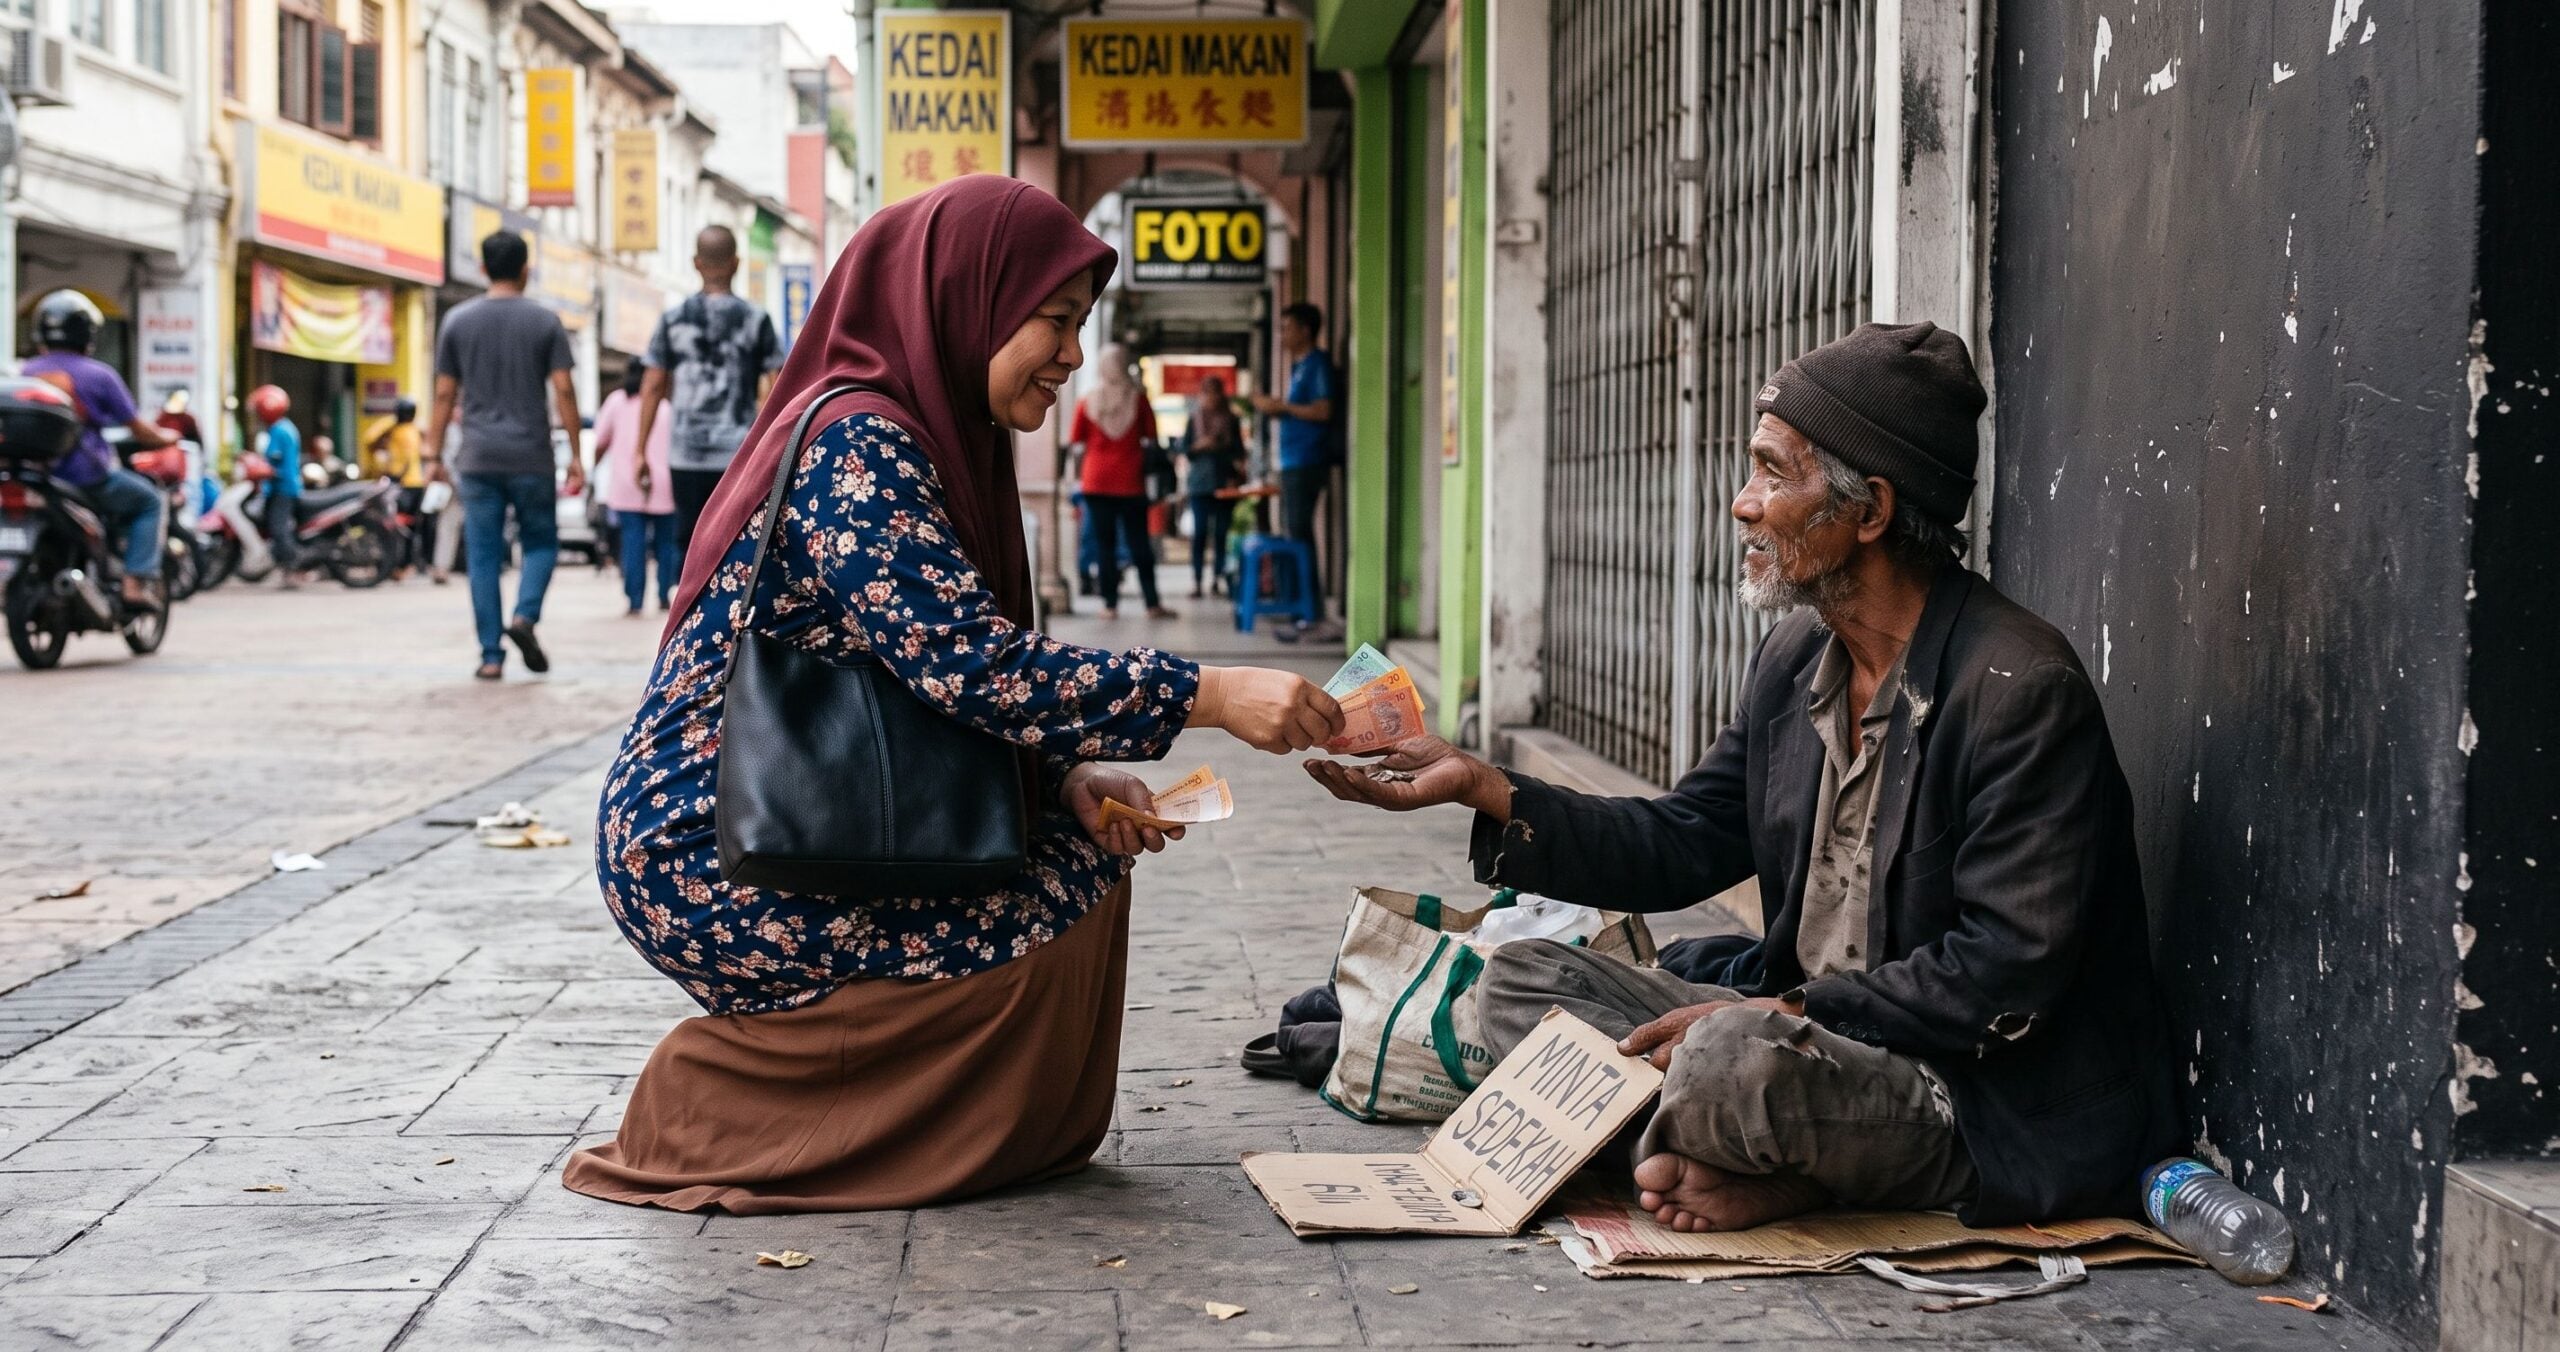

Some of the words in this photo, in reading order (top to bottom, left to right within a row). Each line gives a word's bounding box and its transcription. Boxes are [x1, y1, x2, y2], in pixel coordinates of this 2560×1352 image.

[890, 32, 997, 78] KEDAI
[1079, 33, 1172, 76] KEDAI
[1181, 33, 1292, 76] MAKAN
[889, 90, 997, 133] MAKAN
[1135, 209, 1263, 262] FOTO
[1395, 692, 1406, 702] 10
[1513, 1033, 1627, 1131] MINTA
[1452, 1089, 1577, 1200] SEDEKAH
